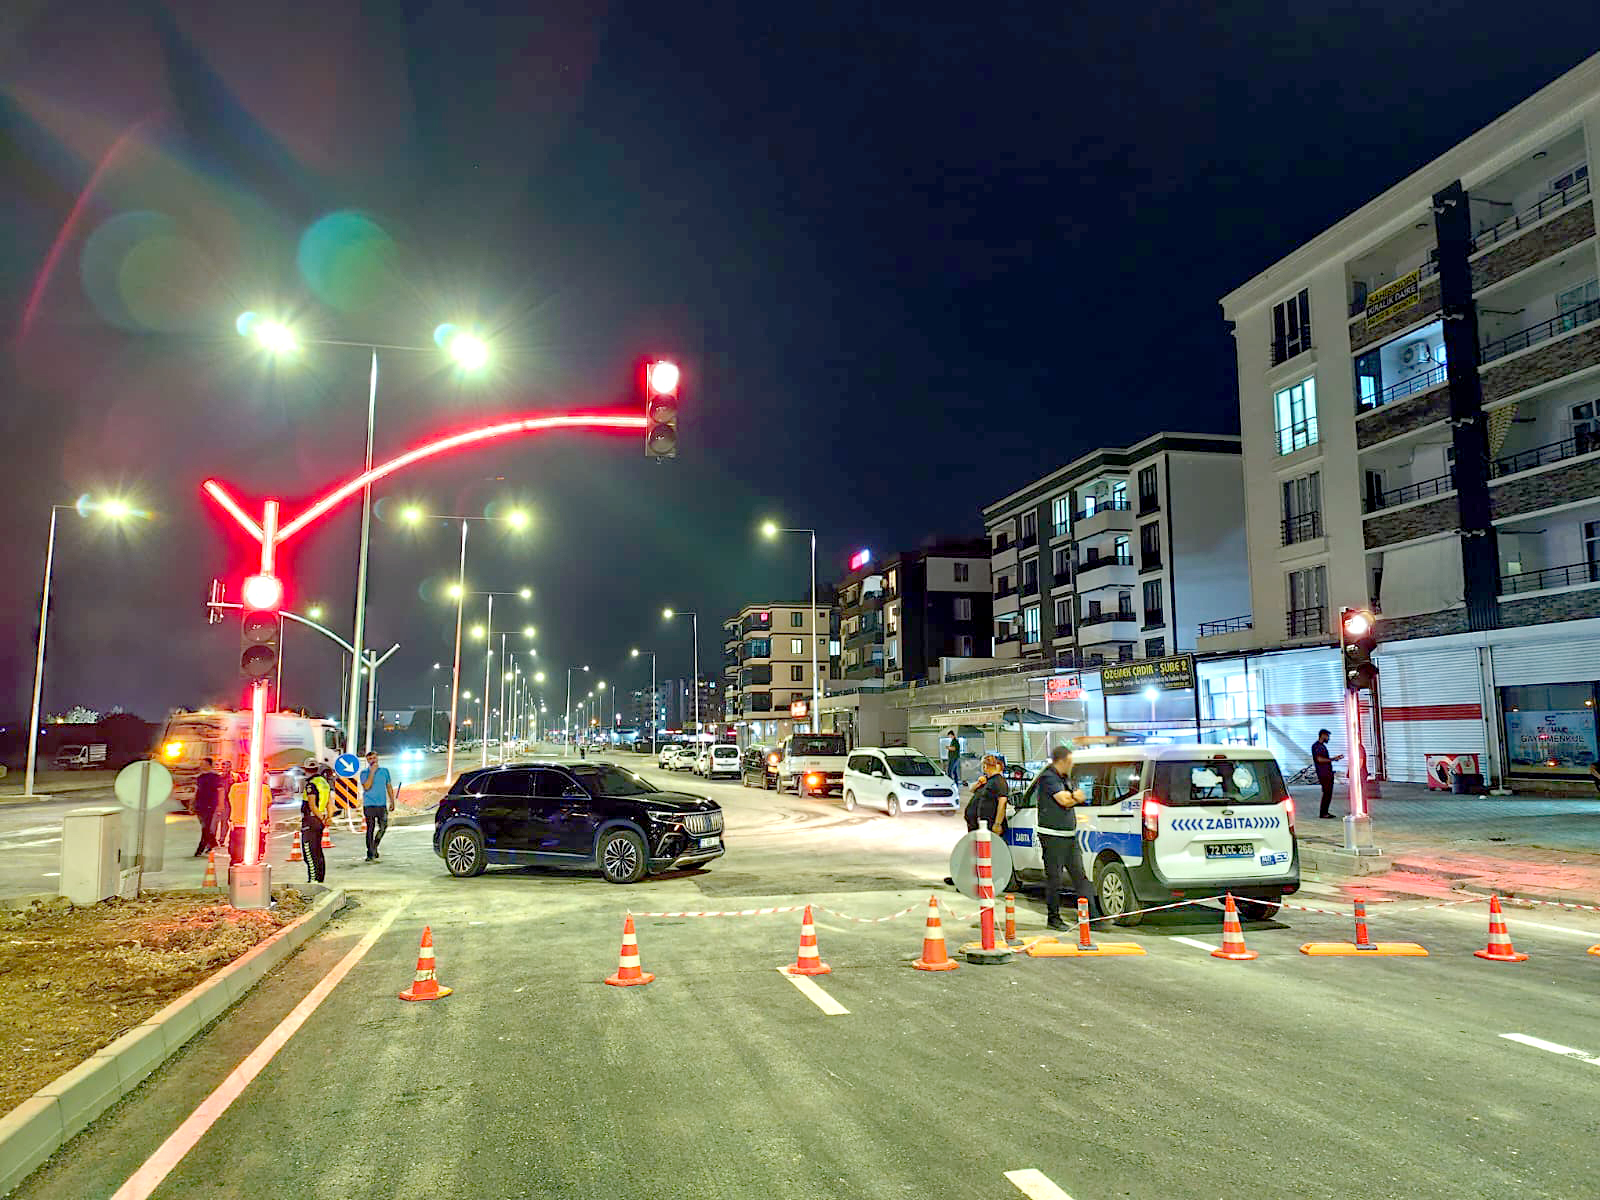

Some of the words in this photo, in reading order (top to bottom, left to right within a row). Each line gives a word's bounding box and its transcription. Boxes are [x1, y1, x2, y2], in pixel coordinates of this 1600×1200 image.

[1206, 817, 1253, 830] ZABITA
[1015, 832, 1030, 842] ZABITA
[1209, 846, 1220, 855] 72
[1222, 845, 1237, 855] ACC
